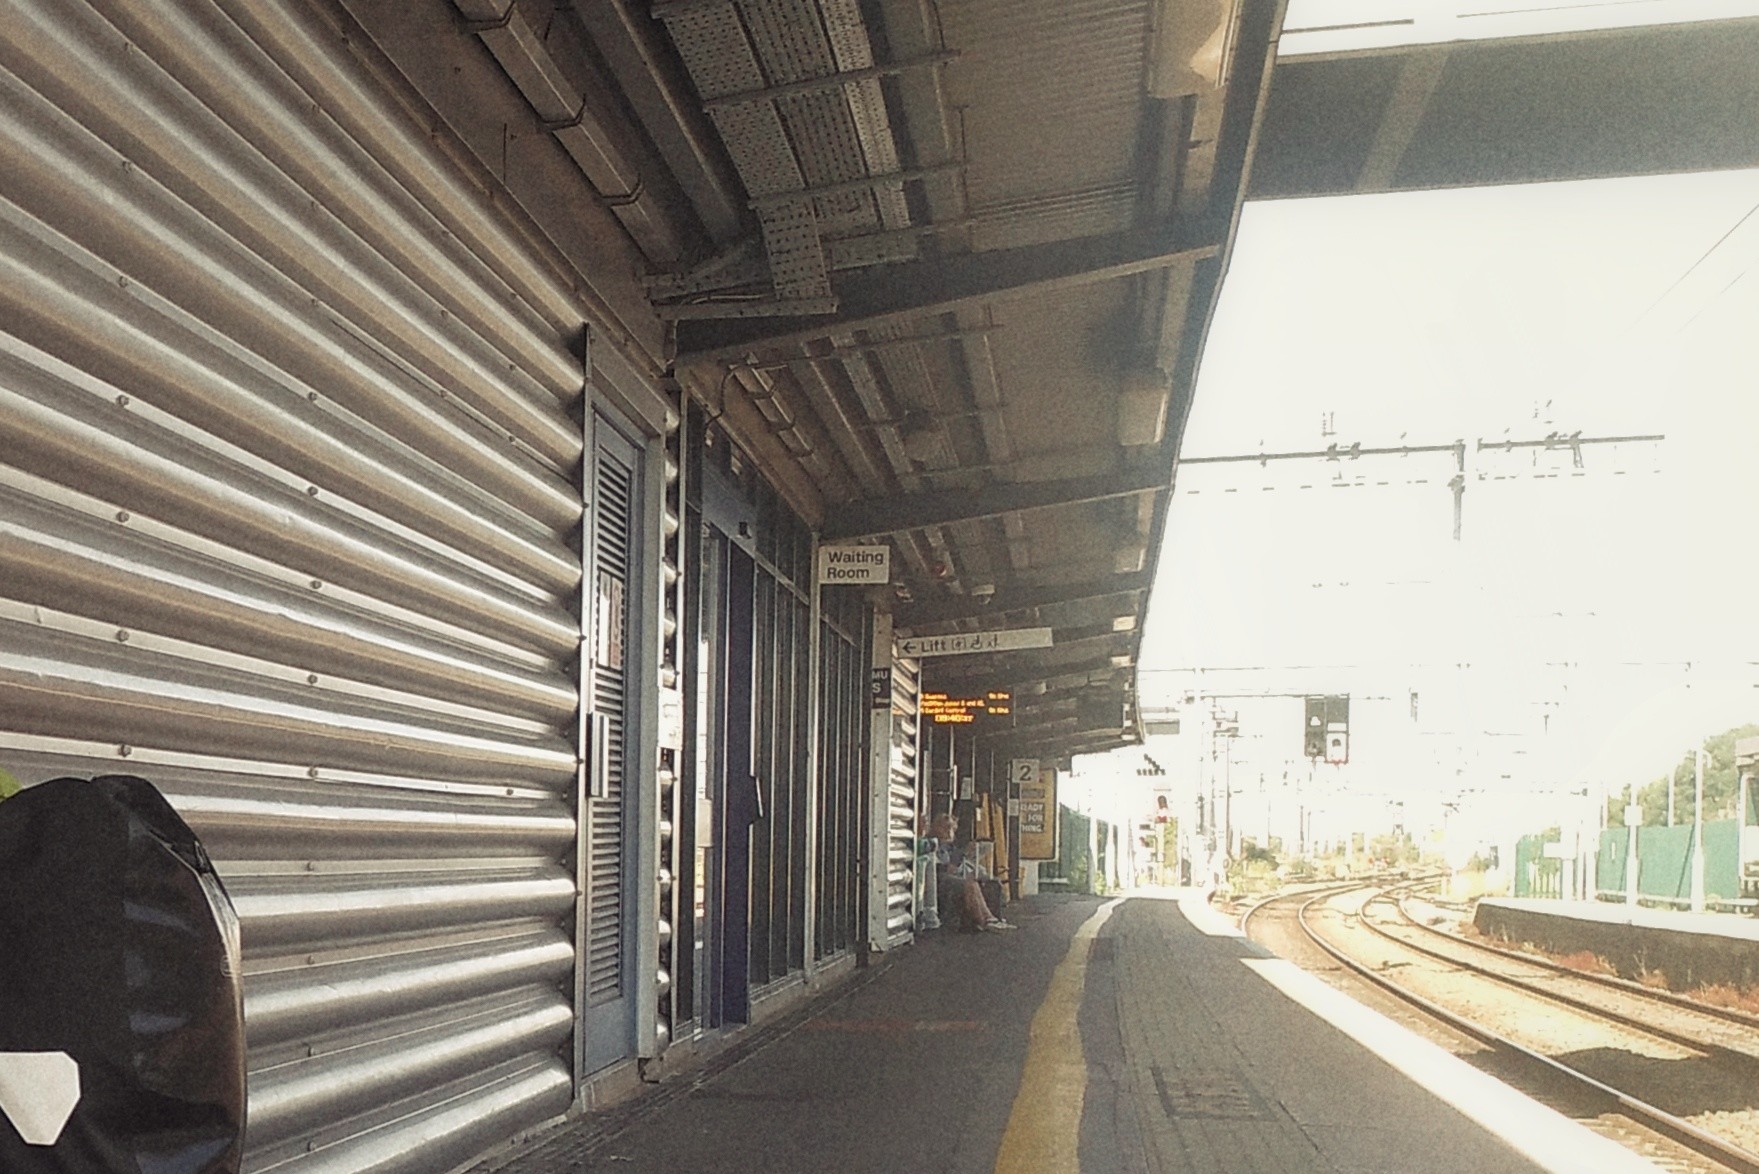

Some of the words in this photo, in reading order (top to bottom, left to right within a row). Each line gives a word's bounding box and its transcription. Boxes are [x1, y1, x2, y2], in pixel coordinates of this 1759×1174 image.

[828, 551, 884, 565] Waiting
[827, 567, 870, 579] Room
[921, 640, 946, 652] Lift
[1020, 765, 1031, 780] 2
